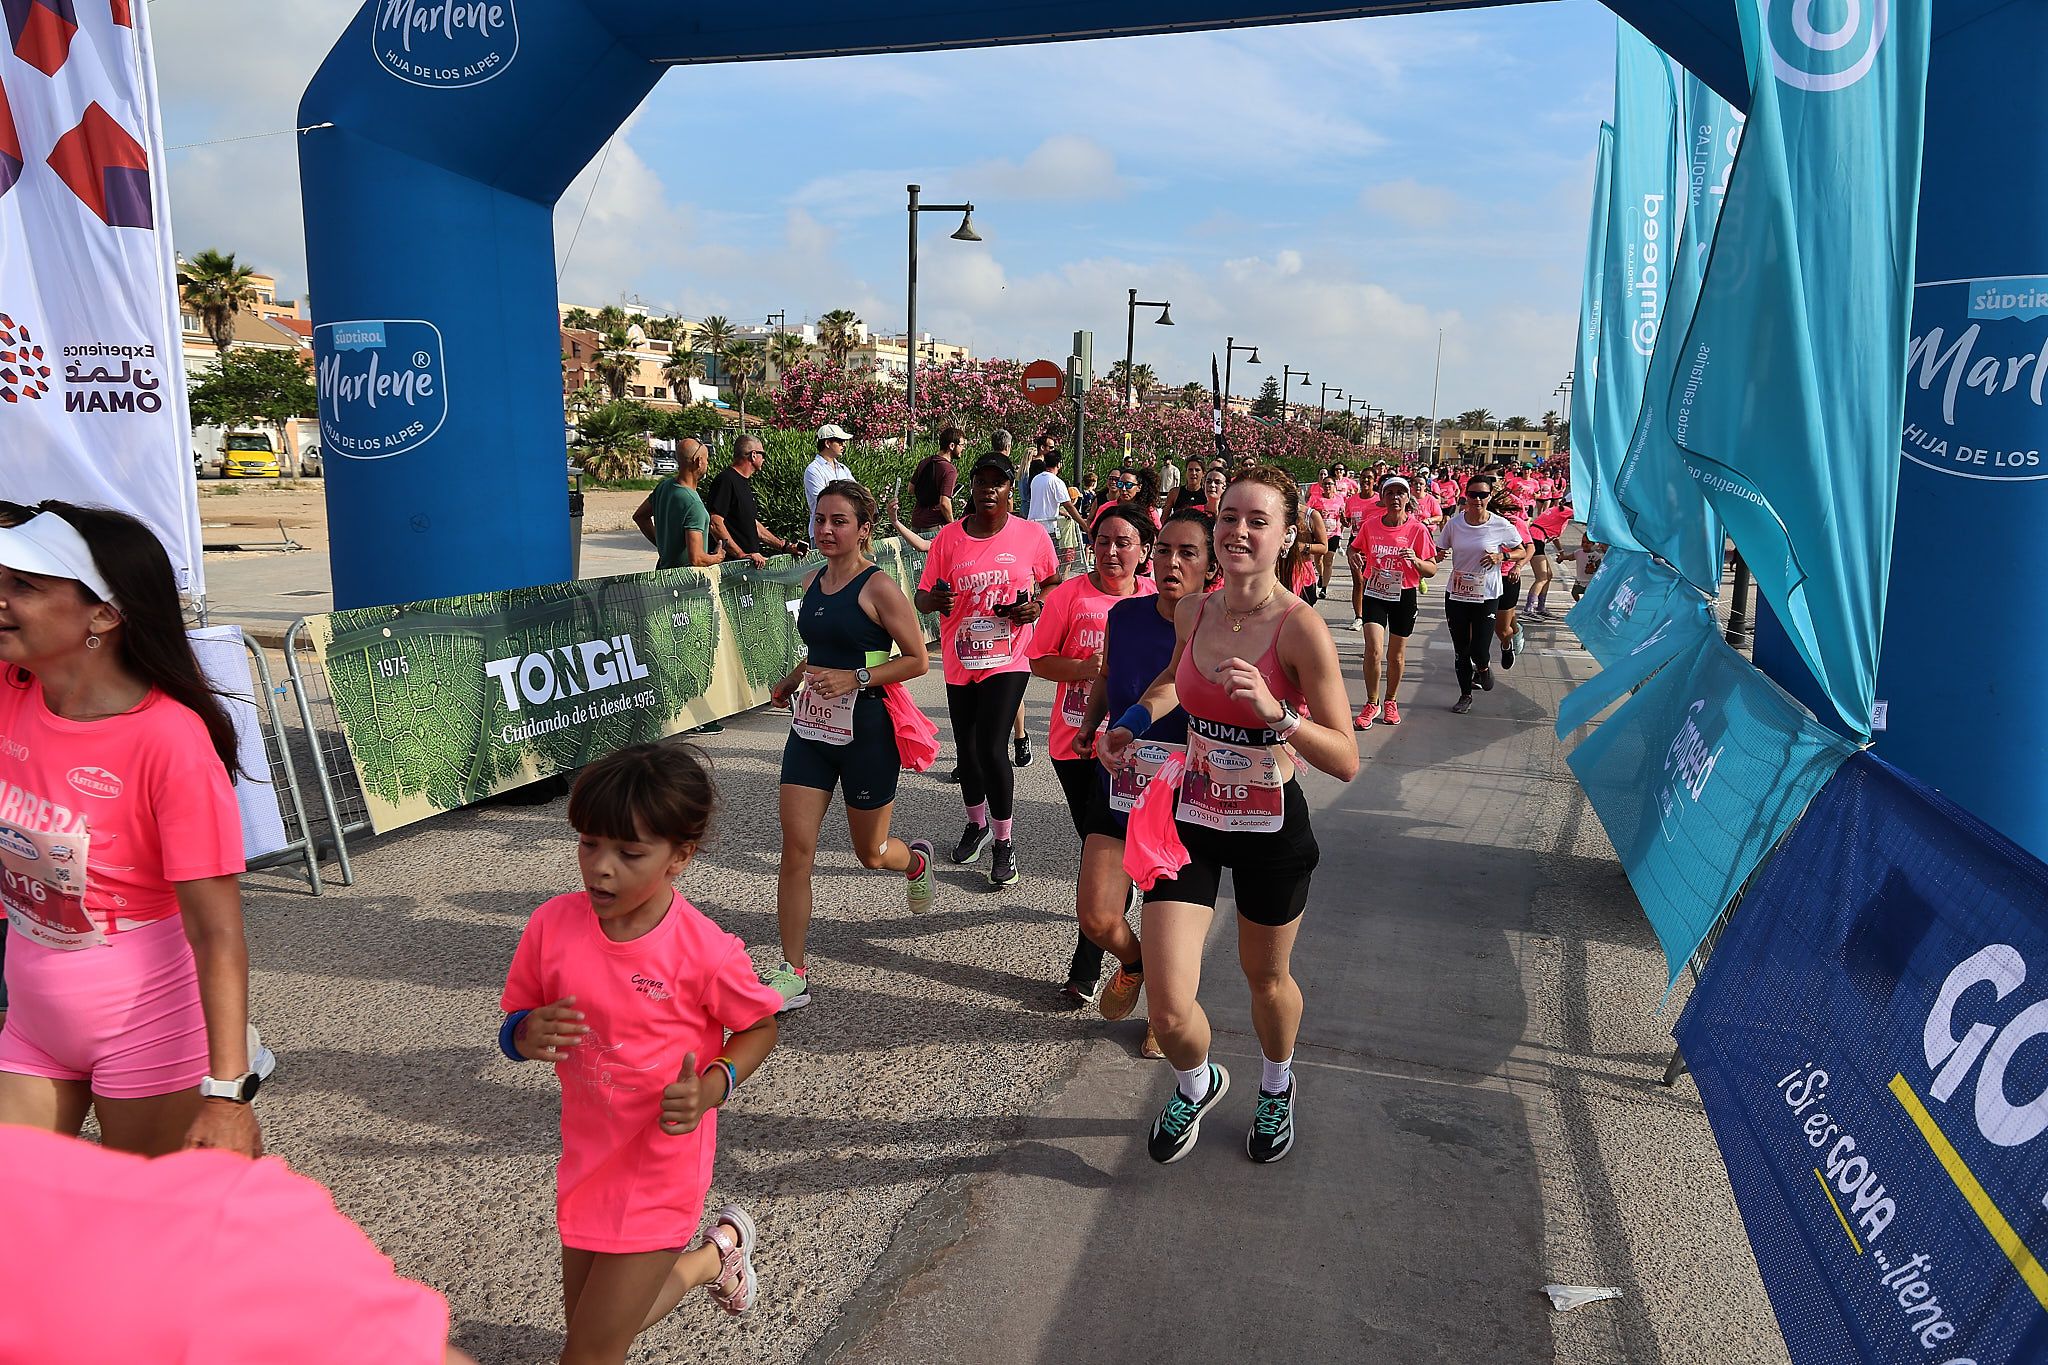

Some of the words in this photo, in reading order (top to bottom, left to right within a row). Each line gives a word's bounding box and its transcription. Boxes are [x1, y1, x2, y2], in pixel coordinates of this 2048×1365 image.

[382, 0, 505, 52] Marlene
[385, 50, 410, 73] HIJA
[414, 65, 431, 78] DE
[435, 69, 460, 80] LOS
[464, 51, 500, 78] ALPES
[319, 350, 434, 422] Marlene
[325, 420, 340, 443] HIJA
[342, 436, 355, 449] DE
[358, 438, 381, 450] LOS
[385, 420, 424, 447] ALPES
[1902, 423, 1948, 457] HIJA
[1955, 446, 1988, 465] DE
[1995, 450, 2040, 467] LOS
[957, 570, 1010, 591] CARRERA
[1376, 582, 1390, 590] 016
[740, 594, 753, 610] 1975
[672, 611, 690, 628] 2026
[1075, 612, 1104, 620] OYSHO
[972, 640, 994, 650] 016
[377, 656, 409, 679] 1975
[502, 714, 570, 745] Cuidando
[571, 706, 588, 724] de
[589, 704, 599, 720] ti
[600, 697, 632, 717] desde
[634, 690, 655, 708] 1975
[809, 705, 832, 719] 016
[1199, 720, 1250, 743] PUMA
[1211, 782, 1249, 800] 016
[1189, 809, 1220, 823] OYSHO
[1239, 818, 1271, 827] Santander
[1247, 808, 1272, 816] VALENCIA
[5, 868, 47, 901] 016
[631, 974, 663, 989] Carrera
[1804, 1113, 1838, 1147] es
[1826, 1135, 1896, 1242] GOYA
